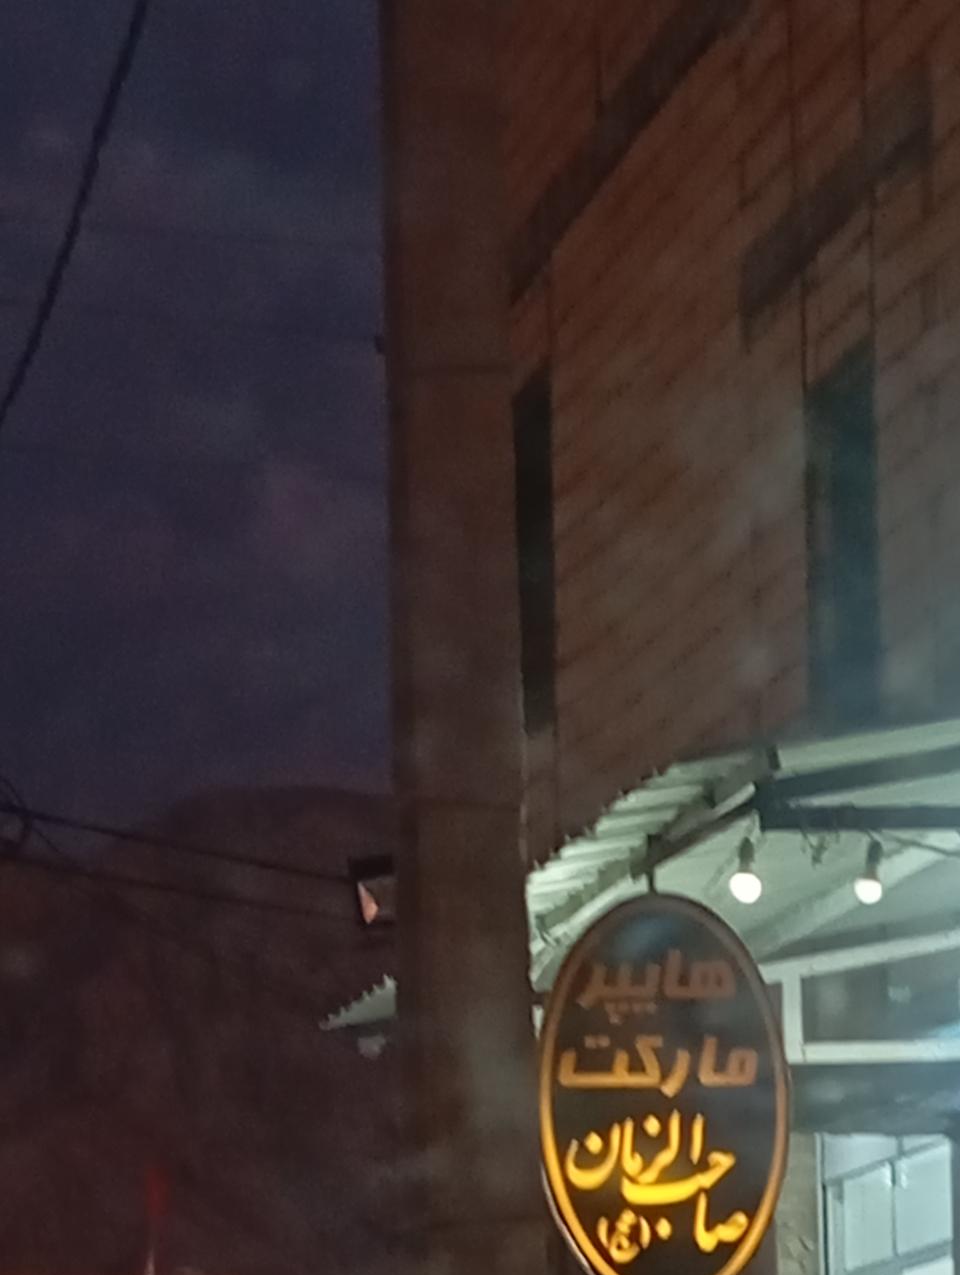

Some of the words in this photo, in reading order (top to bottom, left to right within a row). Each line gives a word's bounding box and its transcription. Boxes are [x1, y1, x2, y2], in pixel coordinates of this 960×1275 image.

[576, 948, 736, 1023] هایپر
[557, 1033, 760, 1098] مارکت
[564, 1108, 706, 1191] الزمان
[621, 1150, 750, 1253] صاحب
